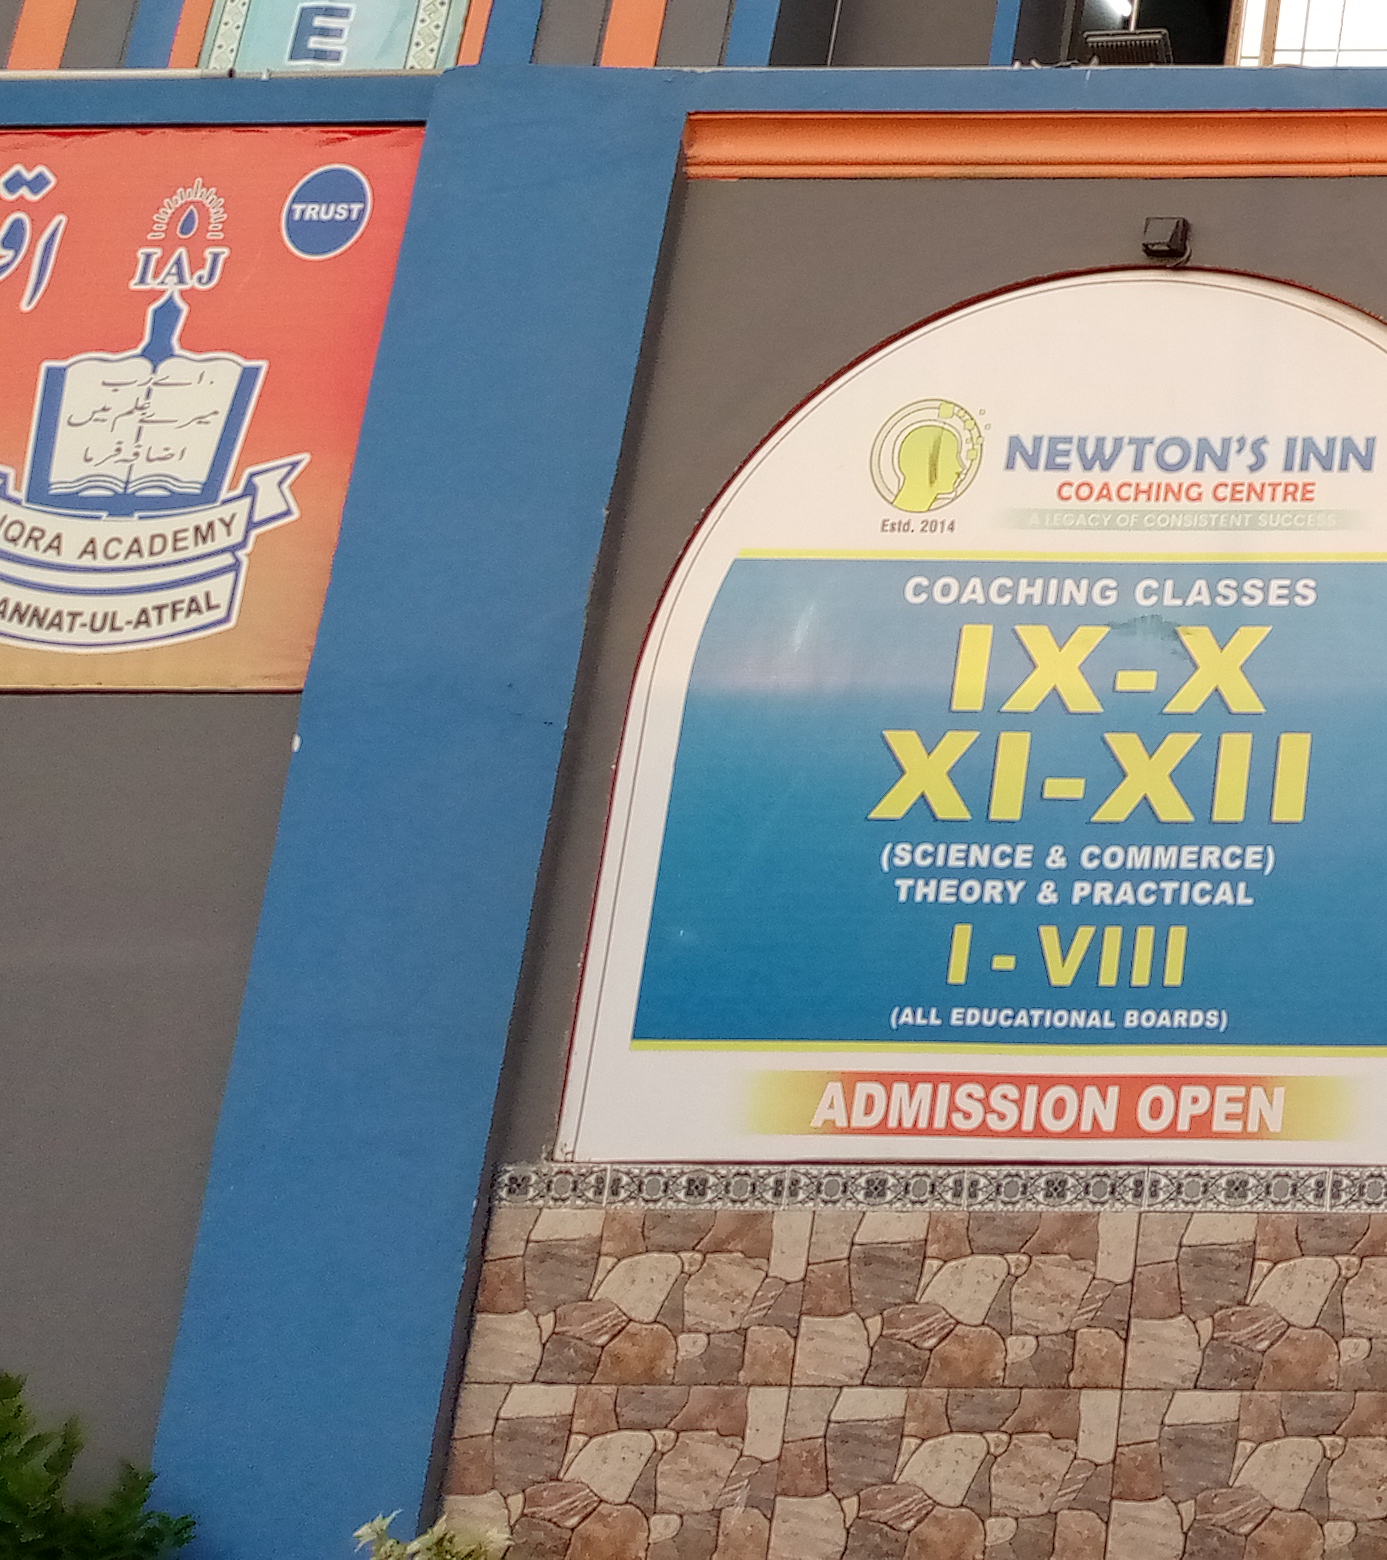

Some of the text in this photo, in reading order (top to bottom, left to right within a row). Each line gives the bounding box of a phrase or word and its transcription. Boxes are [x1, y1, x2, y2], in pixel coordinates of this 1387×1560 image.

[290, 202, 365, 223] TRUST
[130, 247, 231, 290] IAJ
[1003, 433, 1378, 474] NEWTON'S INN
[1056, 478, 1317, 504] COACHING CENTRE
[76, 511, 239, 562] ACADEMY
[920, 518, 956, 535] 2014
[1045, 512, 1110, 528] LEGACY
[1116, 512, 1139, 528] OF
[1143, 513, 1252, 528] CONSISTENT
[903, 575, 1319, 608] COACHING CLASSES
[0, 589, 222, 634] ANNAT-UL-ATFAL
[880, 842, 1275, 876] (SCIENCE & COMMERCE)
[895, 877, 1254, 907] THEORY & PRACTICAL
[890, 1005, 1229, 1033] (ALL EDUCATIONAL BOARDS)
[811, 1080, 1286, 1133] ADMISSION OPEN
